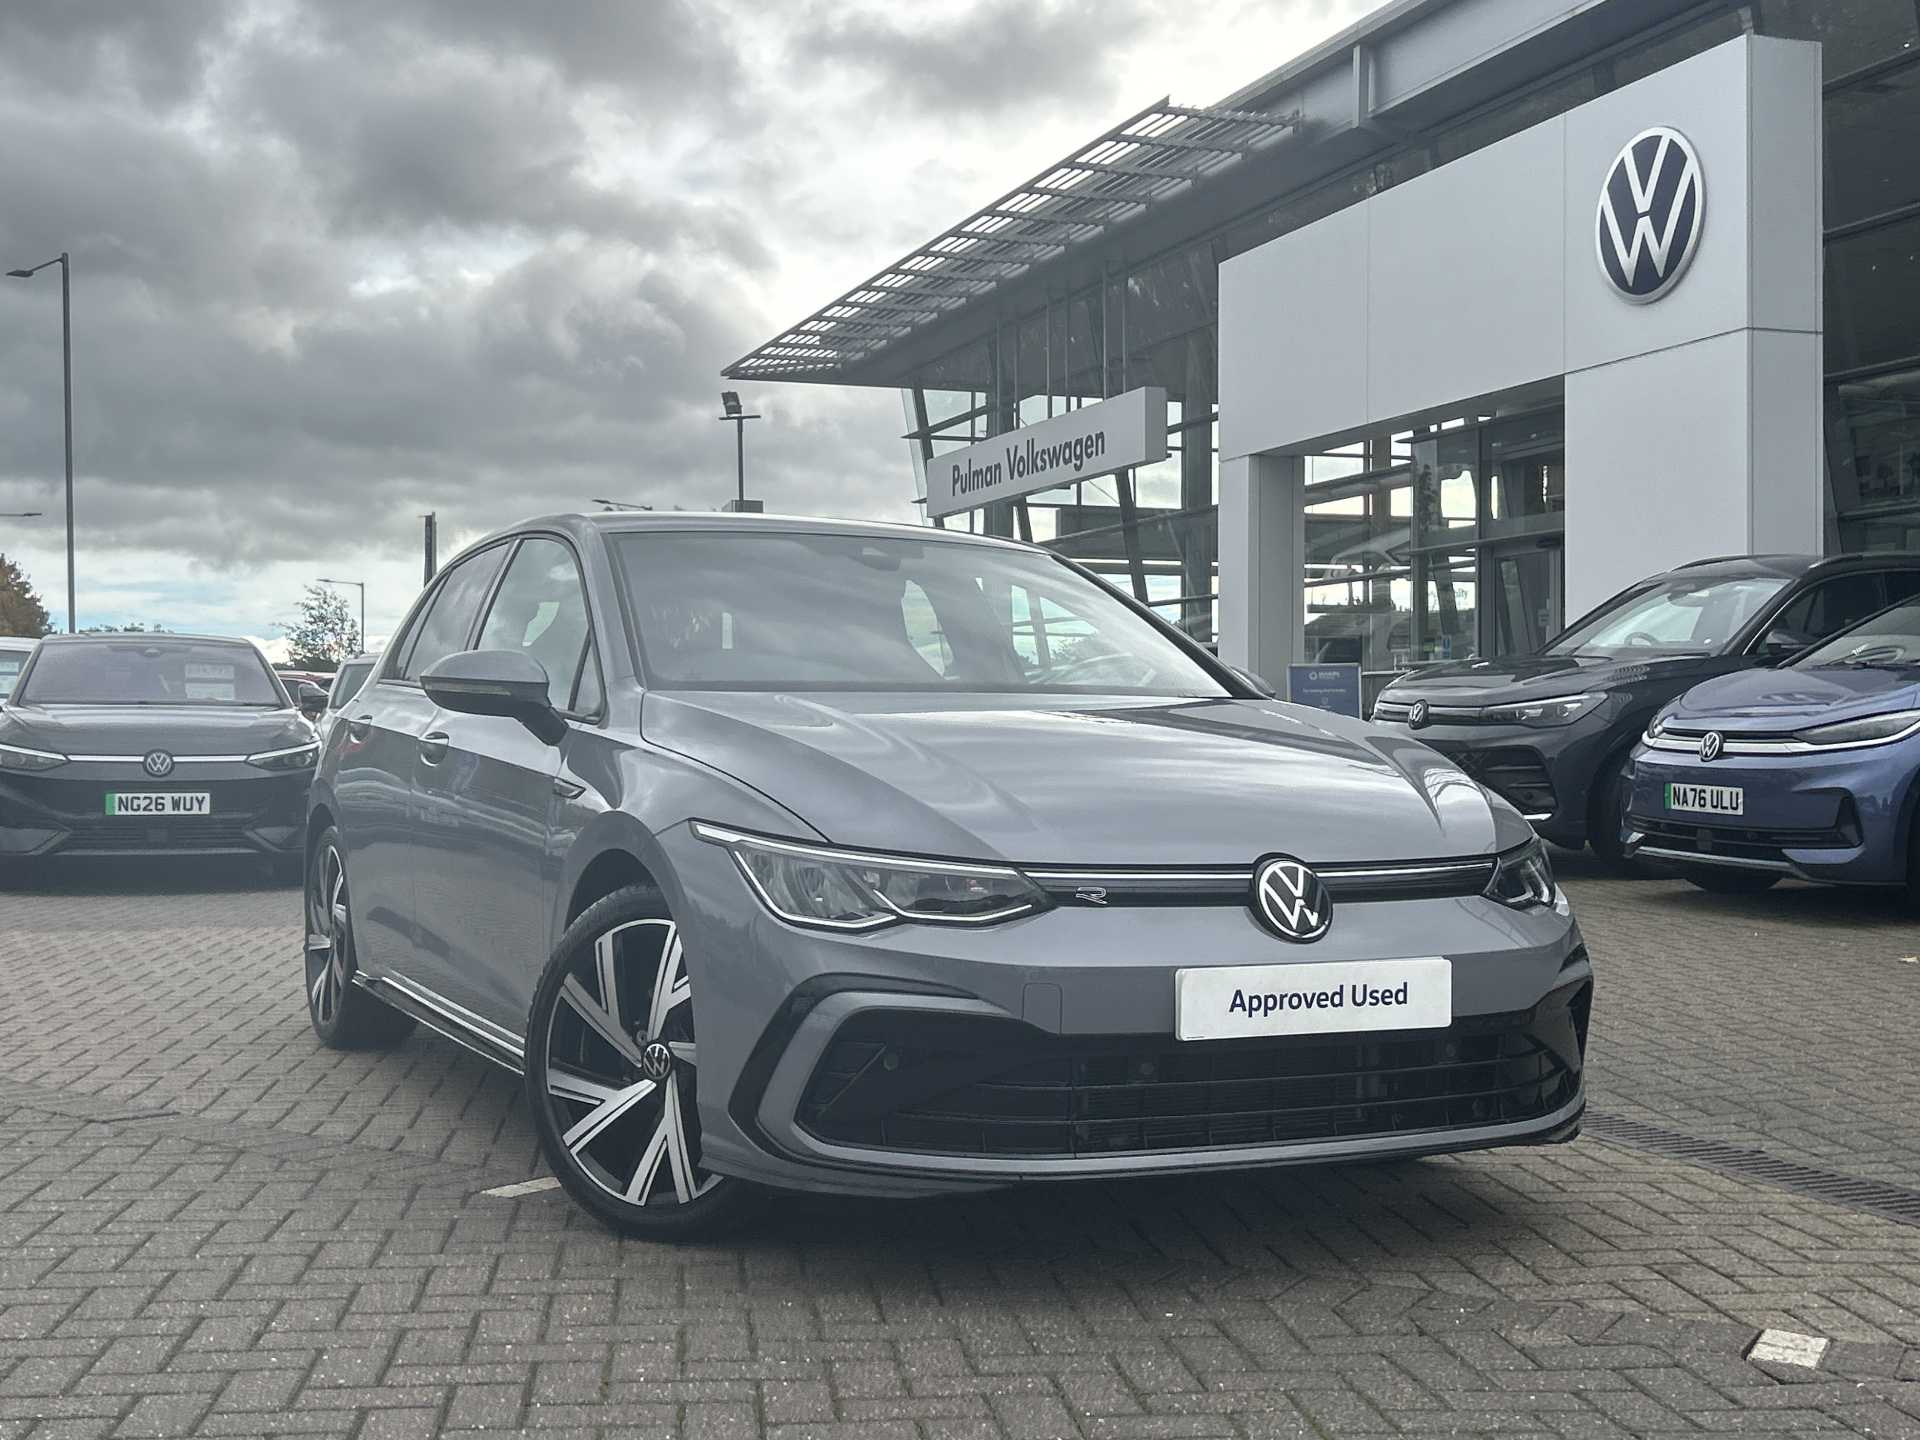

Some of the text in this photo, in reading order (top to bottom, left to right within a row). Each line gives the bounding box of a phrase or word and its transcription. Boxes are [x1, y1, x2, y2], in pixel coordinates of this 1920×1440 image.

[1596, 127, 1706, 304] VW
[952, 431, 1105, 496] Pulman Volkswagen
[118, 796, 205, 812] NG26 WUY
[1673, 786, 1739, 810] NA76 ULU
[1259, 860, 1331, 938] VW
[1229, 982, 1408, 1018] Approved Used
